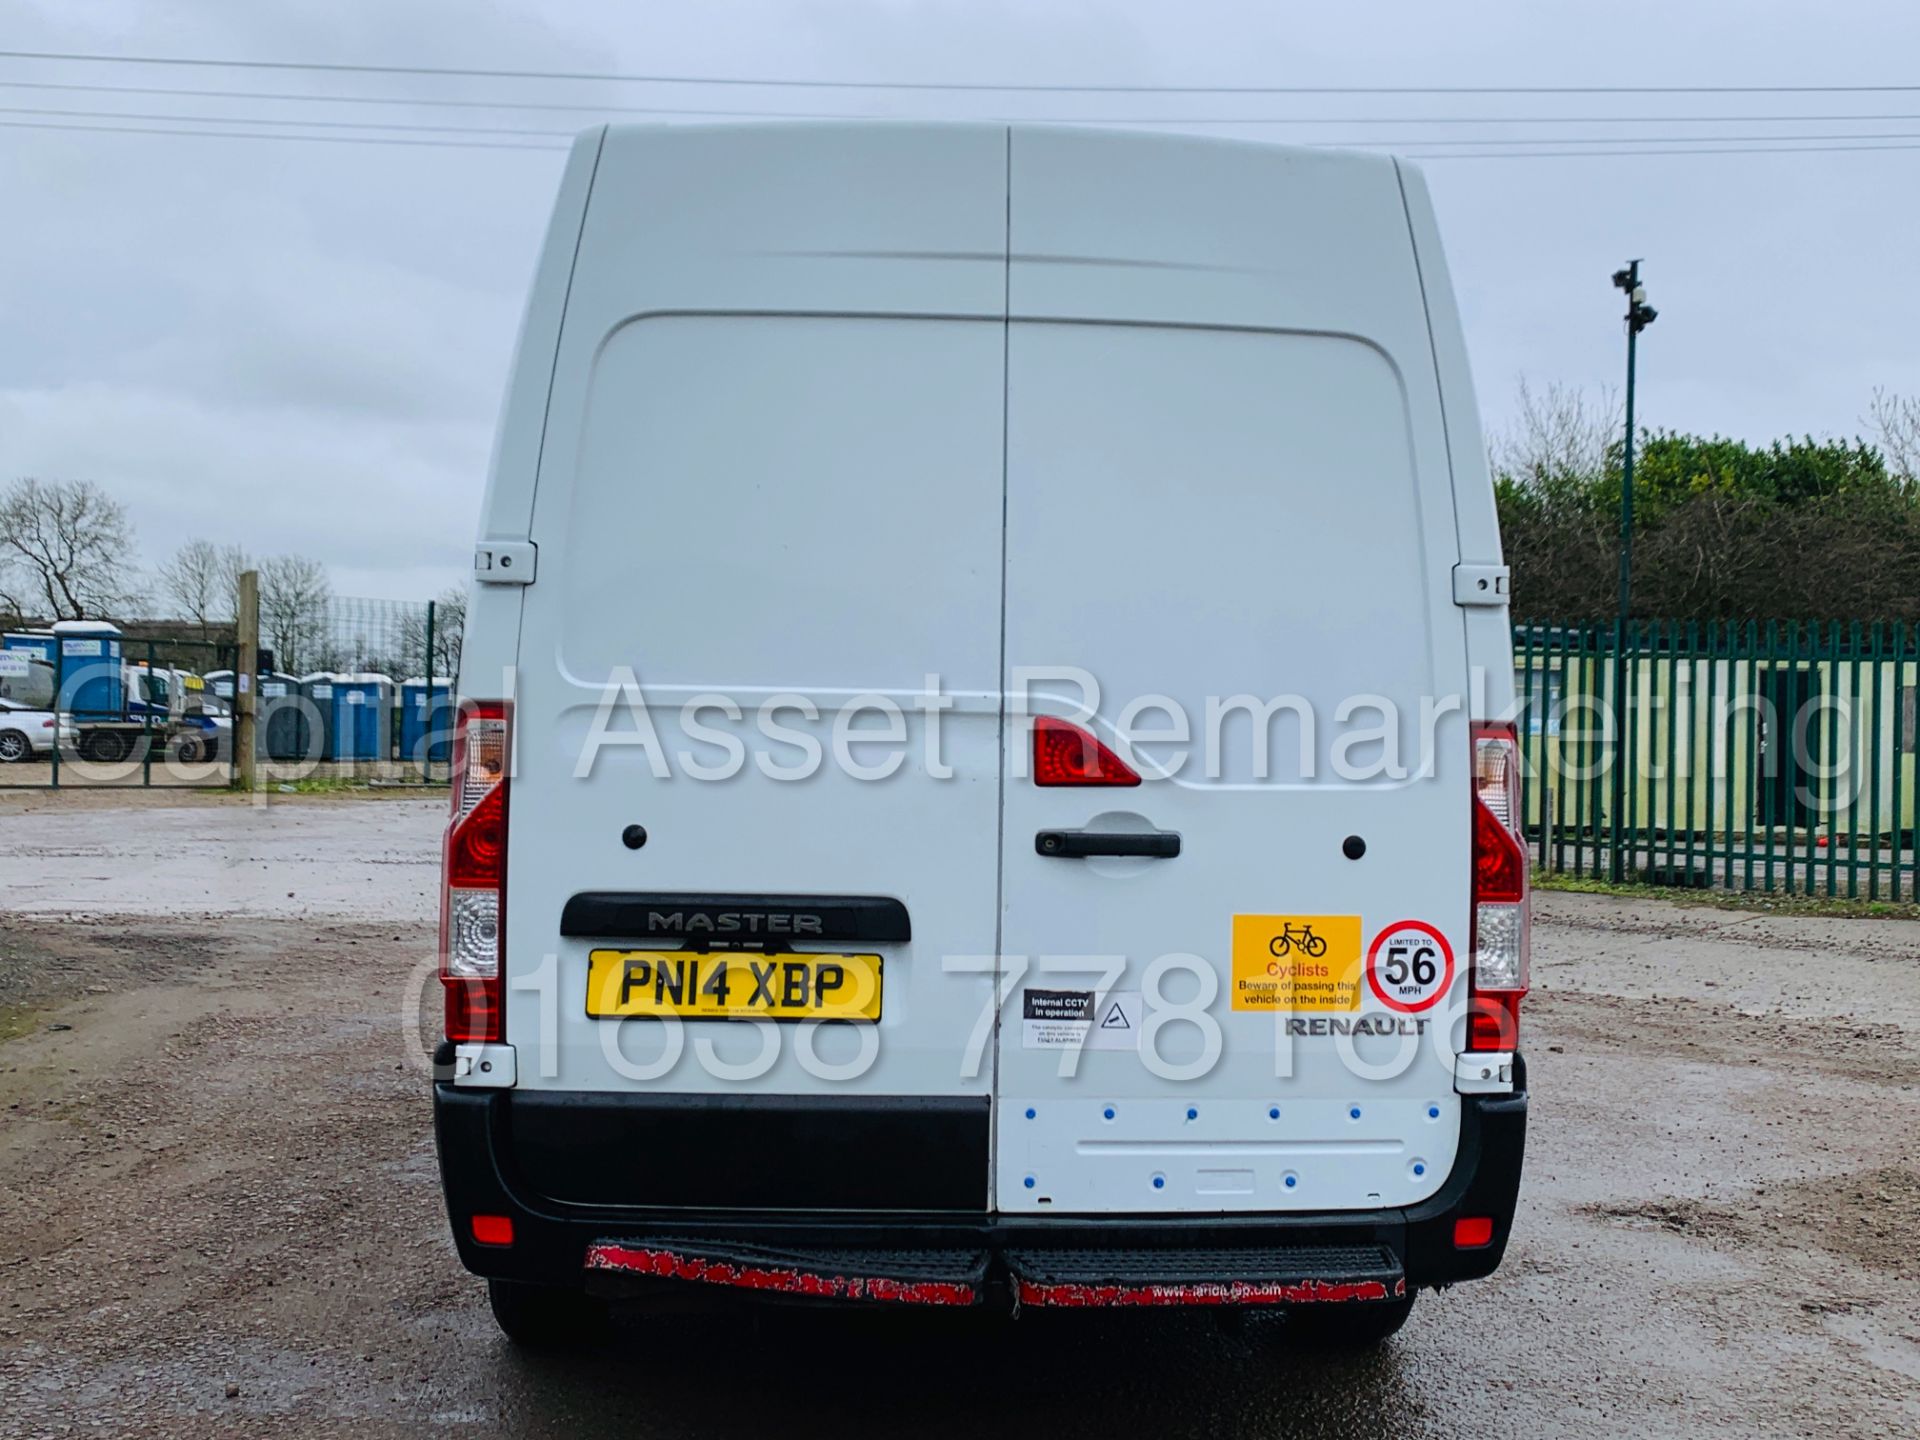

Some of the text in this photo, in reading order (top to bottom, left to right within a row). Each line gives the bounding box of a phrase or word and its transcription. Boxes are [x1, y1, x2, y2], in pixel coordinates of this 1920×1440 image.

[648, 912, 823, 934] MASTER
[1267, 961, 1328, 979] Cyclists
[1385, 947, 1436, 985] 56
[621, 960, 844, 1008] PN14 XBP
[1239, 980, 1356, 992] Beware of passing this
[1399, 987, 1422, 995] MPH
[1031, 997, 1089, 1008] Internal CCTV
[1244, 994, 1350, 1004] vehicle on the inside
[1045, 1008, 1084, 1018] operation
[1285, 1016, 1431, 1036] RENAULT
